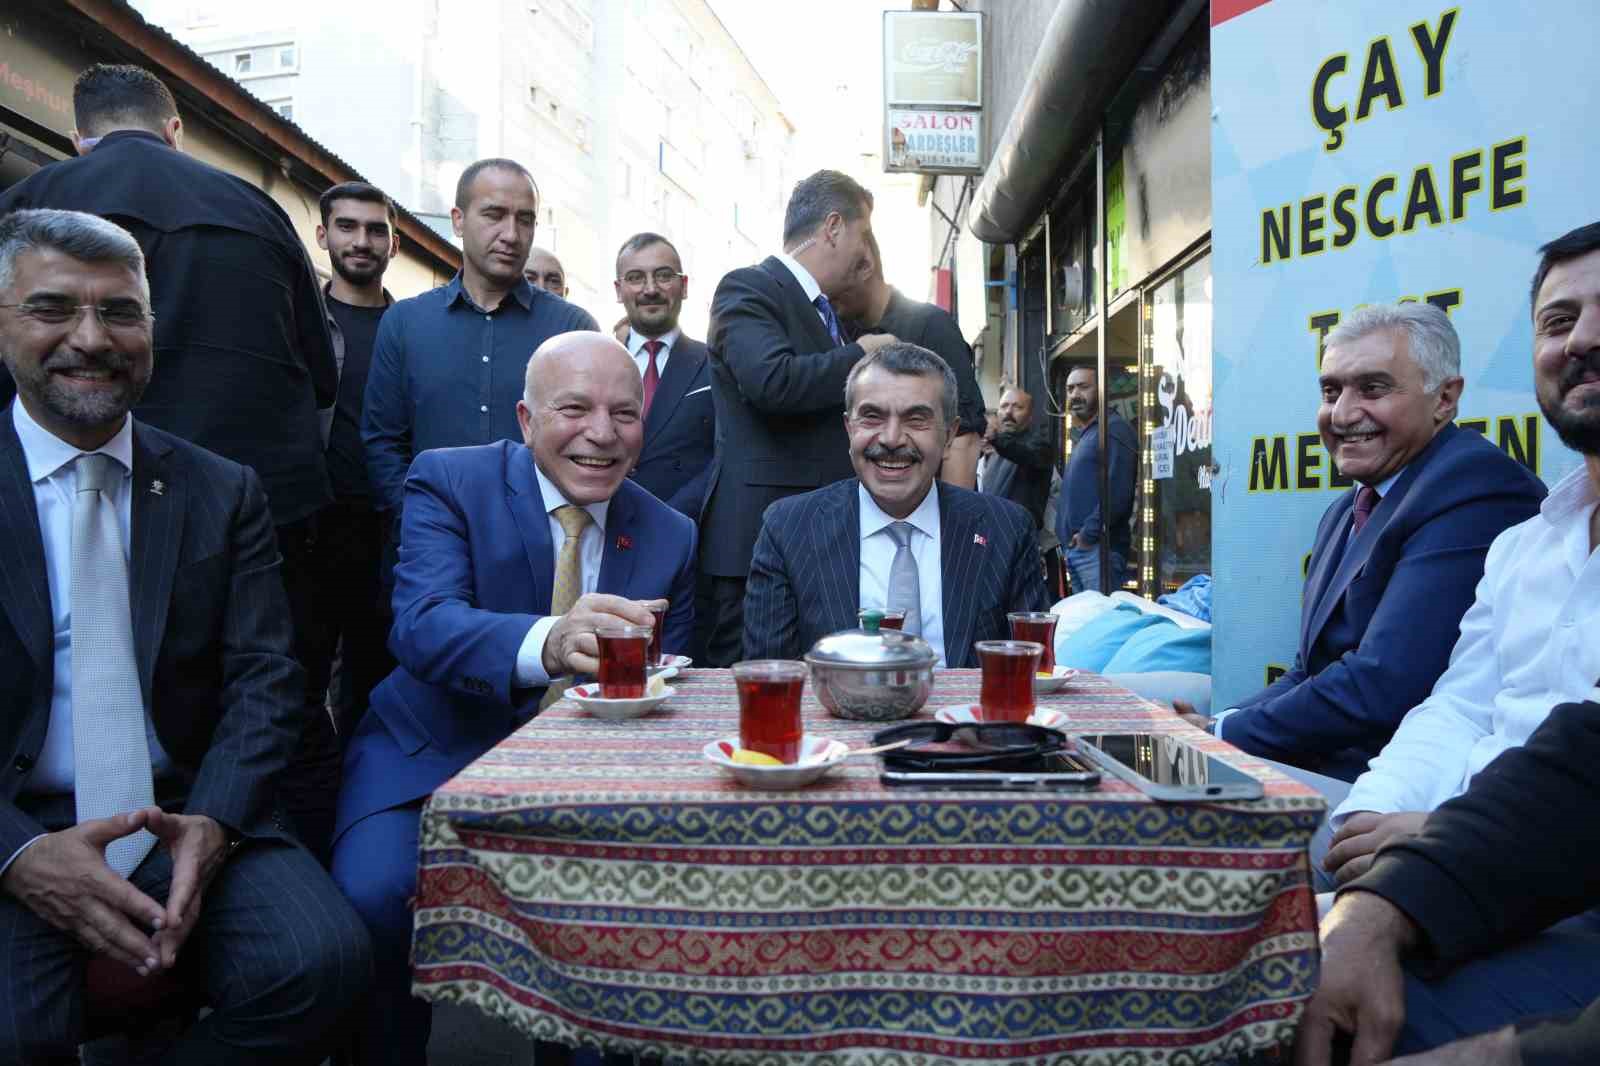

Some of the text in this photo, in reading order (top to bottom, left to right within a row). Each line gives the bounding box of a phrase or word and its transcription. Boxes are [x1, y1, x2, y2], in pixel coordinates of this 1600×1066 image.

[1310, 8, 1459, 151] ÇAY
[898, 134, 977, 153] ARDEŞLER
[1261, 137, 1525, 264] NESCAFE
